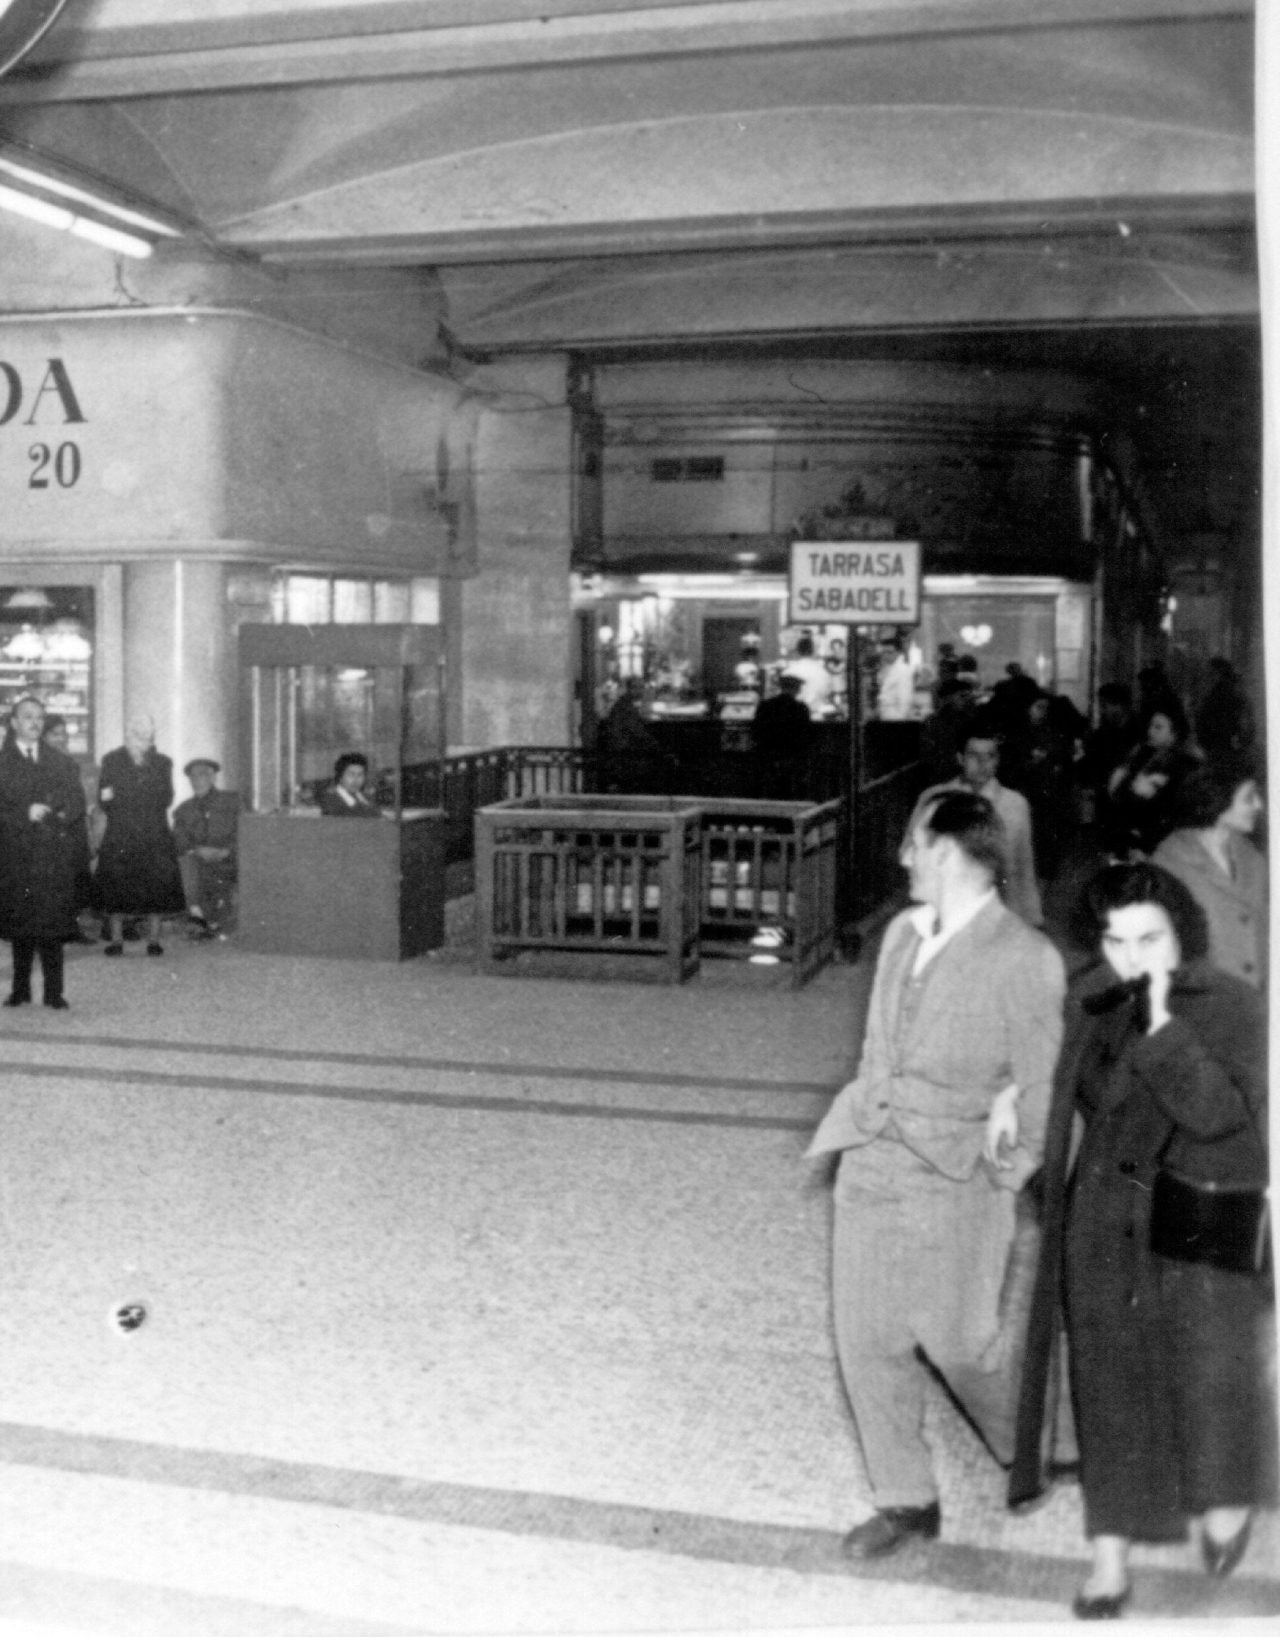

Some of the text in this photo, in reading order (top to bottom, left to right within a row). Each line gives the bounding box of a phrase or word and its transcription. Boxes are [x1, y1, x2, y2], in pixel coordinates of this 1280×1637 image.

[28, 441, 81, 489] 20
[808, 553, 905, 577] TARRASA
[798, 587, 911, 612] SABADELL
